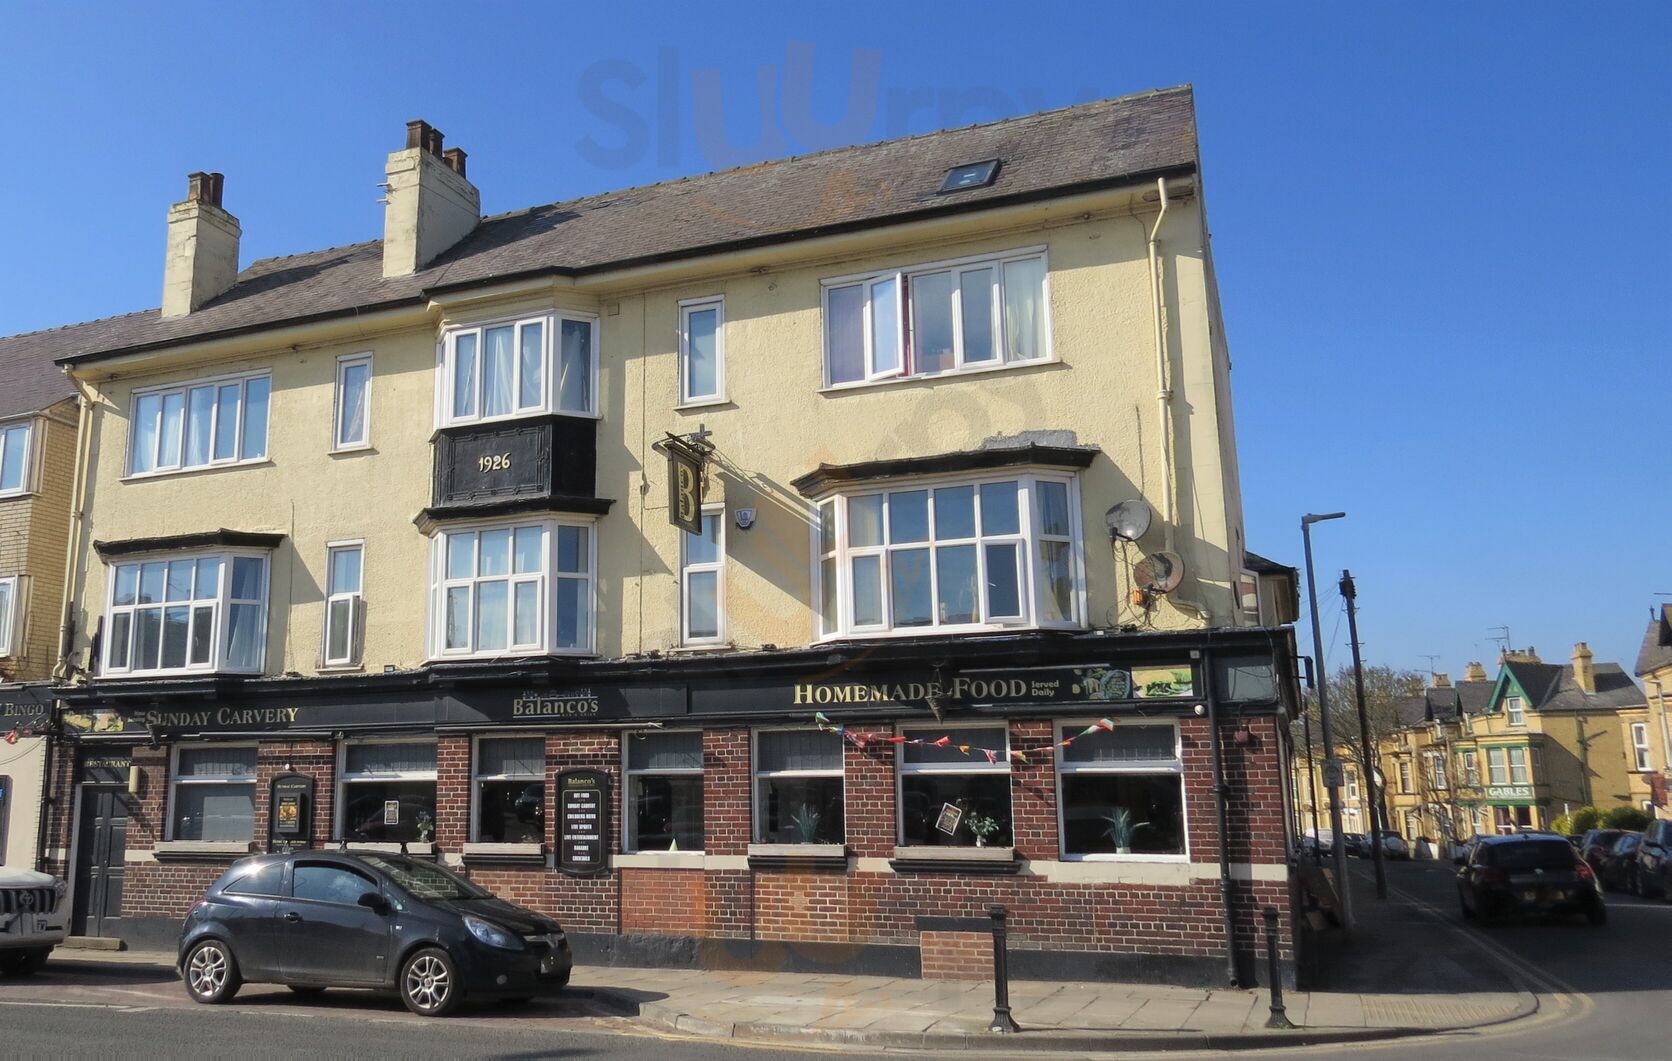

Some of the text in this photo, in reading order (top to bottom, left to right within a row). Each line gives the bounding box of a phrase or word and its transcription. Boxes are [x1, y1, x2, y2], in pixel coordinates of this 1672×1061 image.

[478, 452, 511, 473] 1926
[677, 461, 695, 522] B
[793, 677, 1027, 705] HOMEMADE FOOD
[1031, 679, 1060, 689] Served
[1031, 688, 1056, 697] Daily
[3, 703, 44, 717] BINGO
[513, 697, 599, 715] Balanco's
[145, 710, 212, 727] SUNDAY
[216, 707, 299, 725] CARVERY
[84, 759, 132, 768] RESTAURANT
[1488, 786, 1529, 796] GABLES
